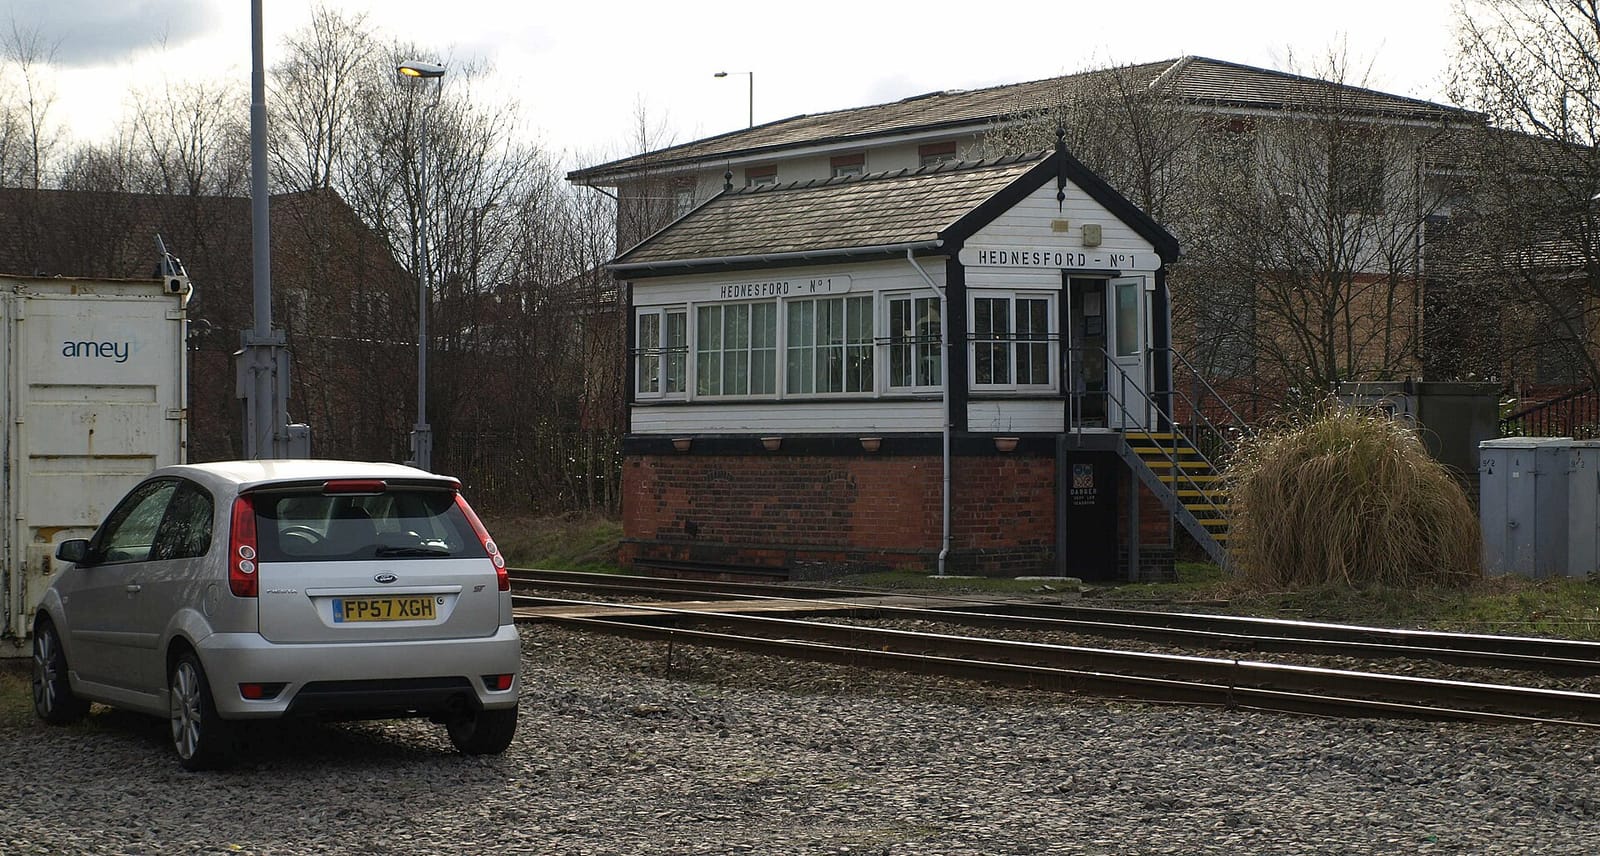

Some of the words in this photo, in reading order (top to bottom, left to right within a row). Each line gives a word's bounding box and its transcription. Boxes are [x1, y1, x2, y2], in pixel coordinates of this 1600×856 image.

[979, 250, 1086, 267] HEDNESFORD
[1129, 255, 1135, 268] 1
[720, 281, 789, 299] HEDNESFORD
[827, 278, 832, 292] 1
[62, 341, 129, 363] amey
[345, 600, 393, 618] FP57
[398, 598, 433, 617] XGH
